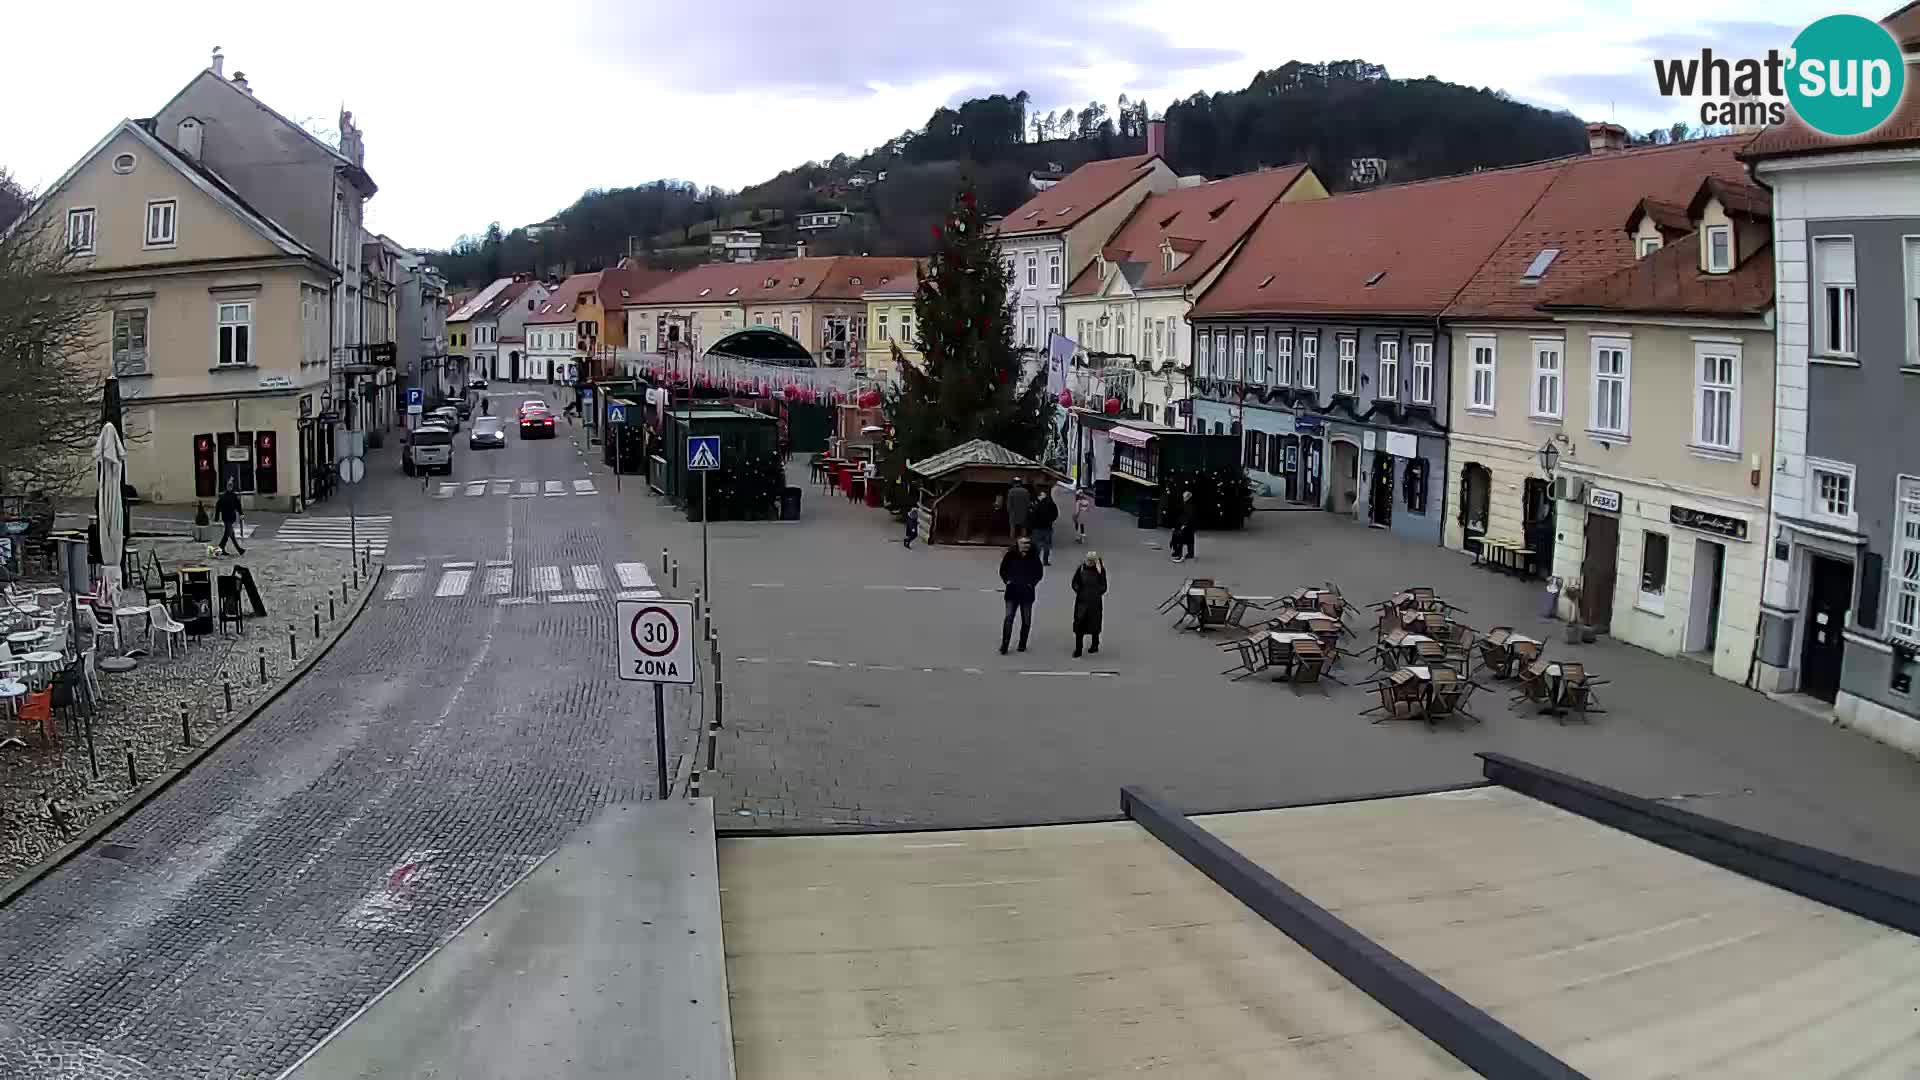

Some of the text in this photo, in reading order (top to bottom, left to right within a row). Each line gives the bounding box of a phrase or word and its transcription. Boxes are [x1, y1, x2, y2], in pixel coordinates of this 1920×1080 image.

[411, 391, 419, 403] P
[643, 622, 668, 643] 30
[634, 660, 678, 676] ZONA
